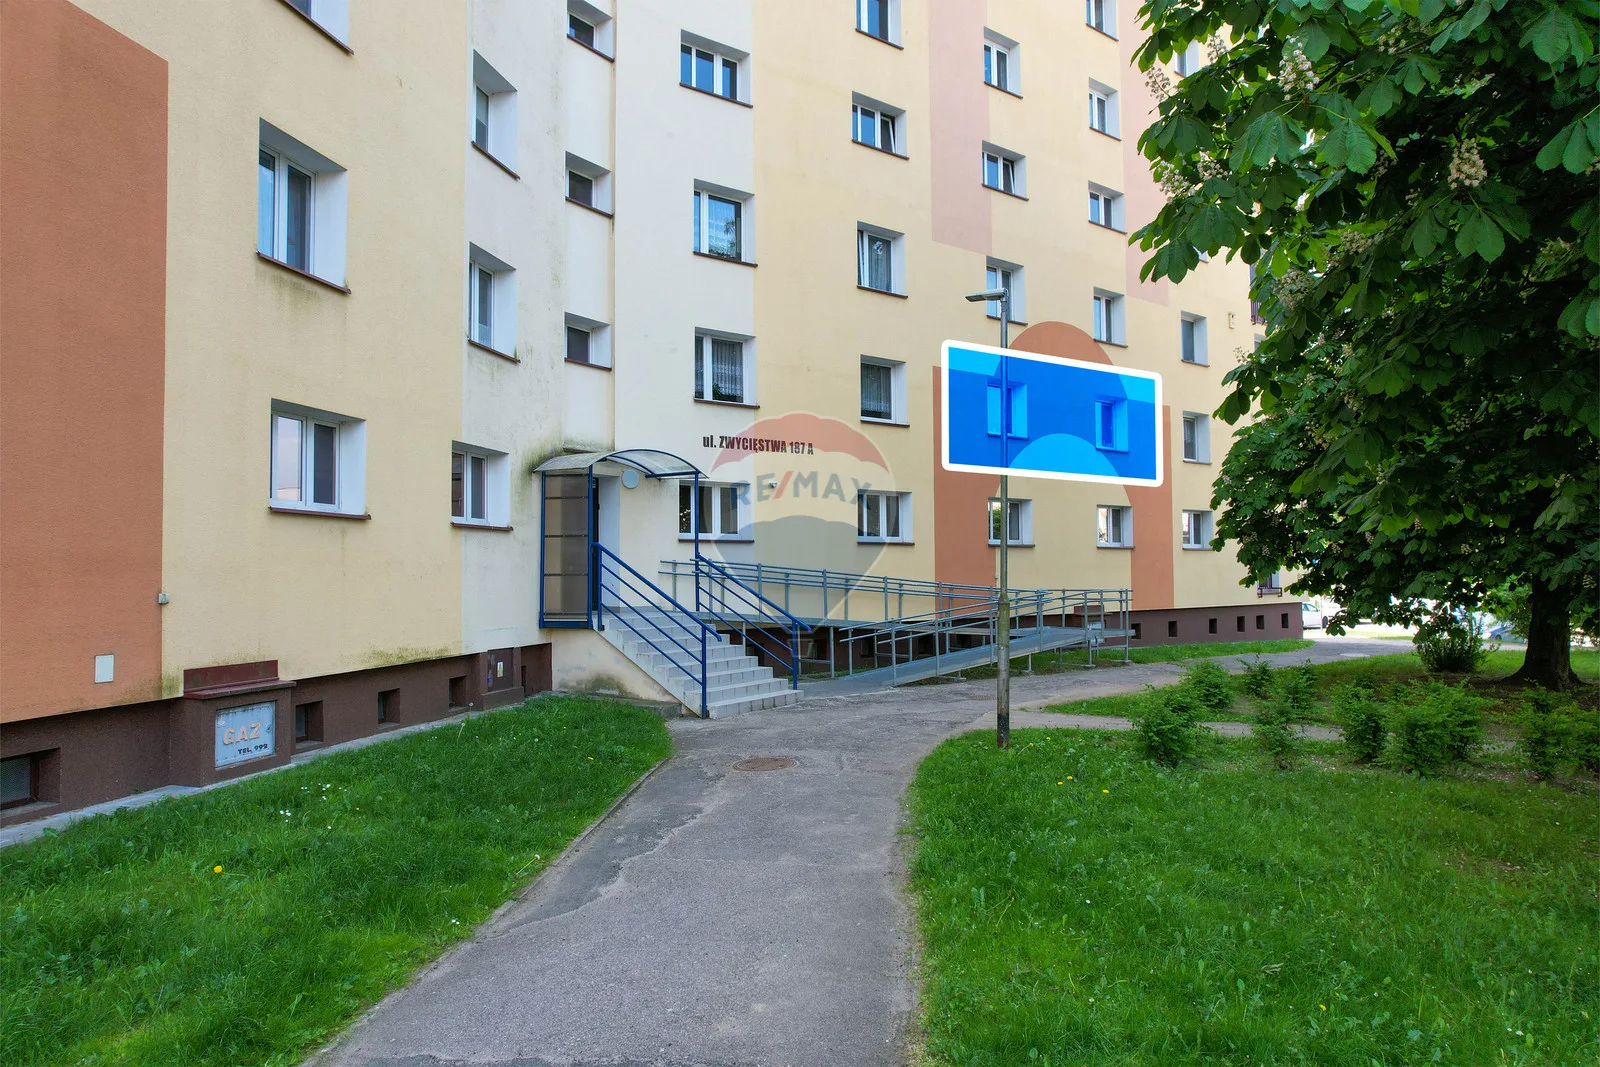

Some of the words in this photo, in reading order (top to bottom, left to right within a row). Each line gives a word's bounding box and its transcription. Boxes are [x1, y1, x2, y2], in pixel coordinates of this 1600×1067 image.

[703, 435, 716, 447] ul.
[719, 436, 787, 453] ZWYCIĘSTWA
[807, 443, 814, 455] A
[223, 723, 260, 745] GAZ
